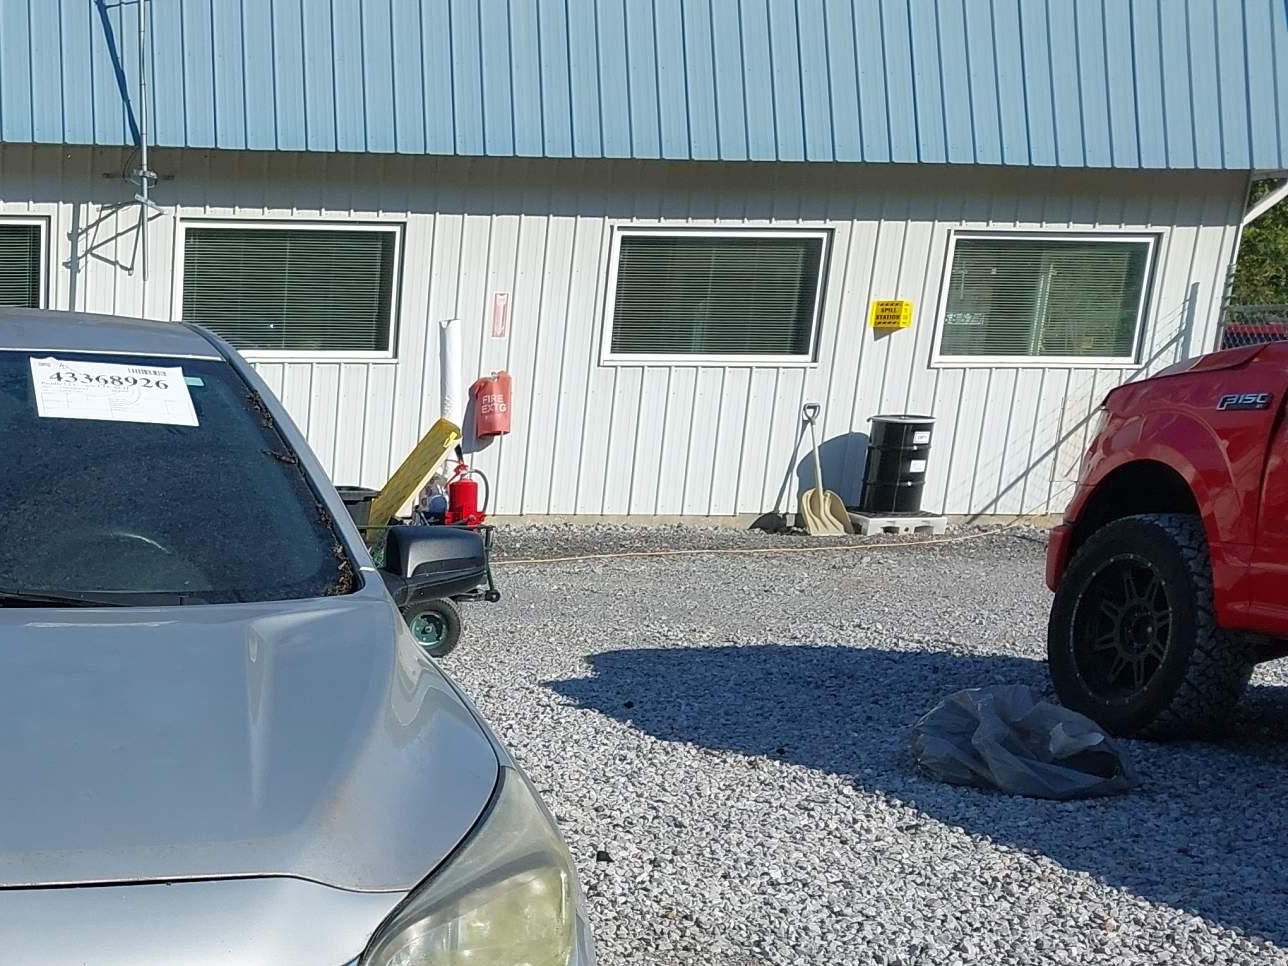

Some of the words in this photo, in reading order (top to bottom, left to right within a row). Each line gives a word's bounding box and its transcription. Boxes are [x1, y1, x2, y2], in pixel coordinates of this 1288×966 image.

[49, 371, 169, 390] 43368926
[482, 394, 504, 404] FIRE
[481, 403, 507, 414] EXTG
